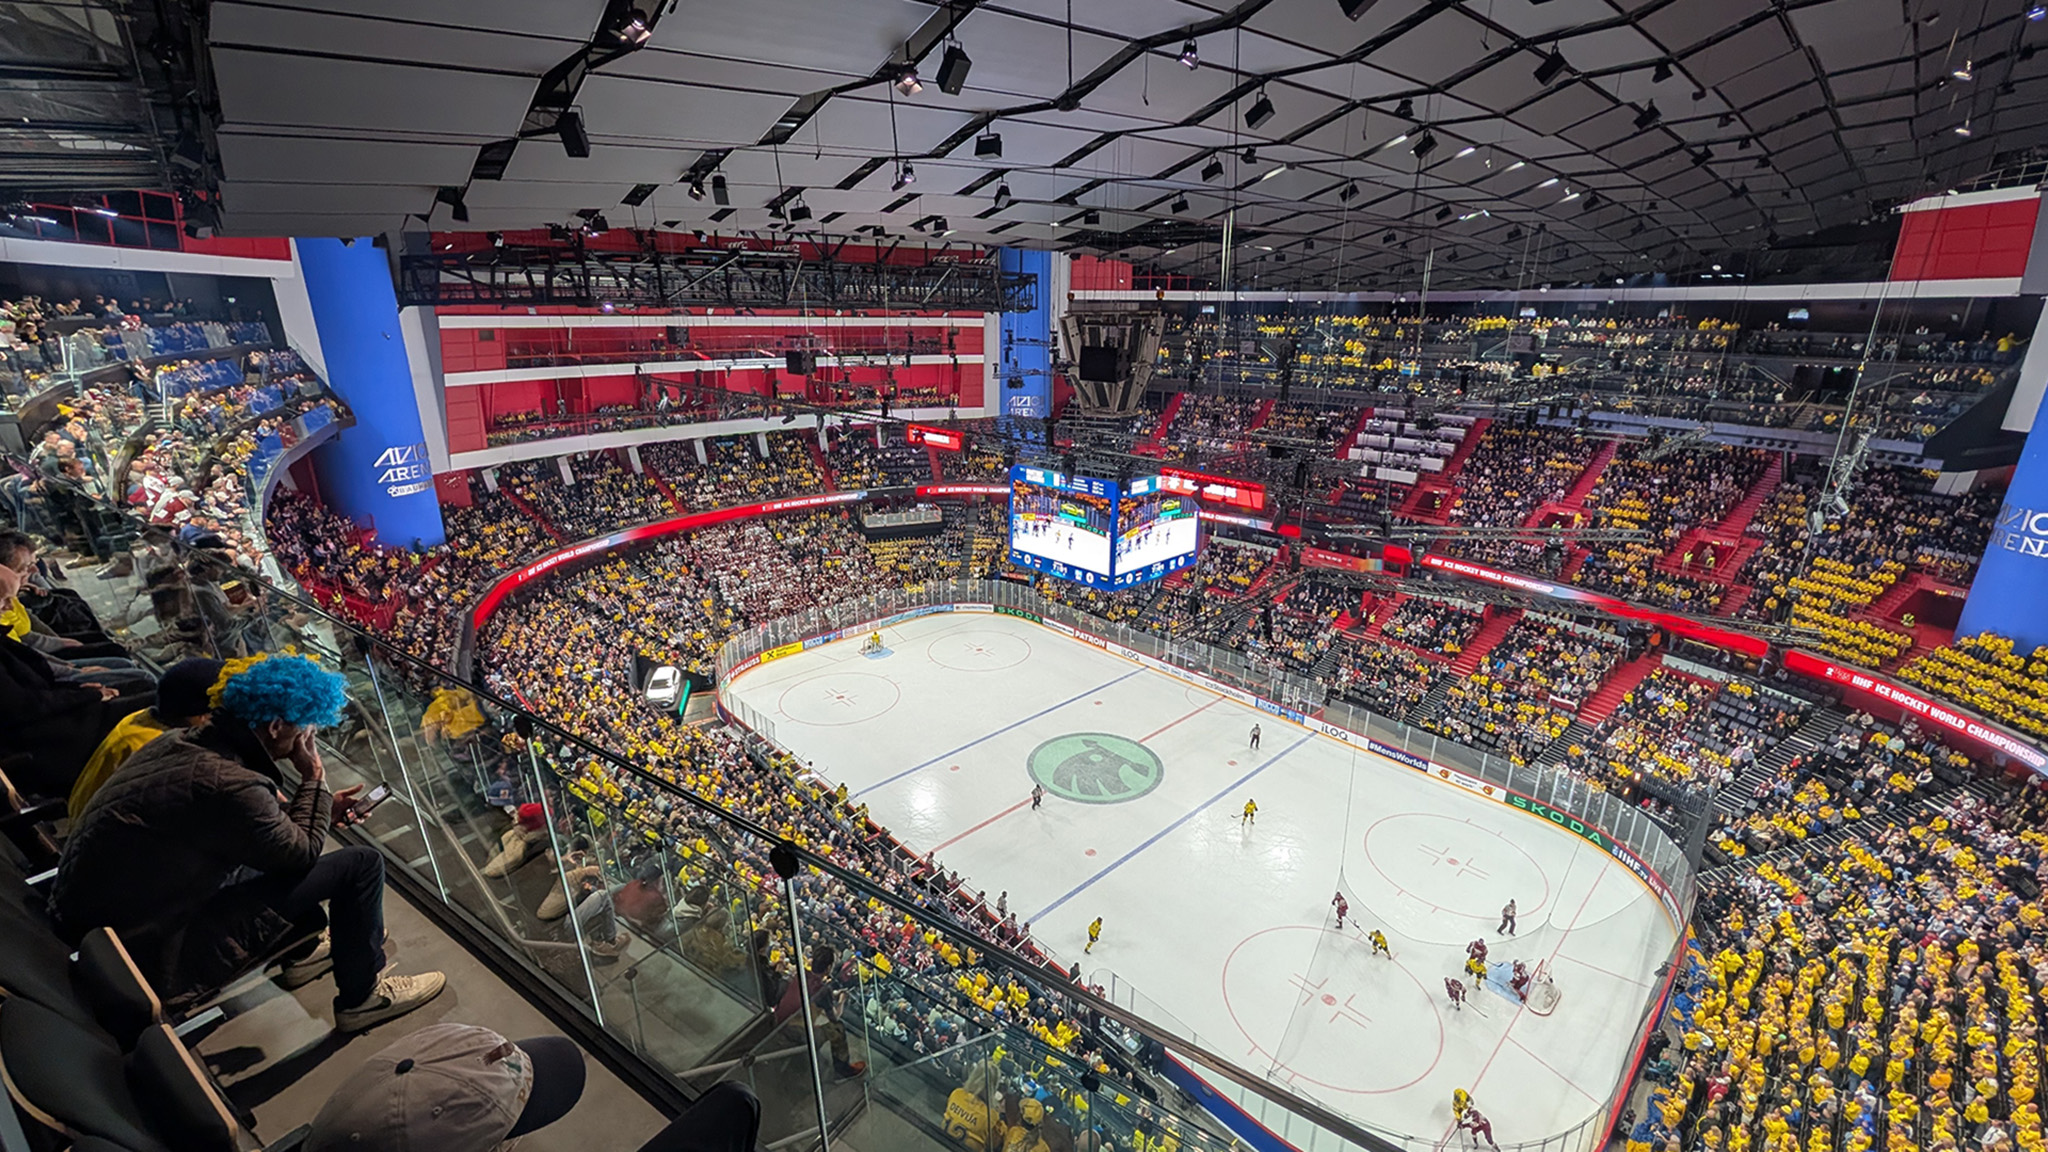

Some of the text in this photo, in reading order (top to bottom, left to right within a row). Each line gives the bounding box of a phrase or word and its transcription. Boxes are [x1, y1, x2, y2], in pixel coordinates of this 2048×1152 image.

[1454, 563, 1479, 575] HOCKEY
[1479, 568, 1502, 581] WORLD
[1075, 630, 1106, 648] PATRON
[1852, 675, 2046, 767] IIHF ICE HOCKEY WORLD CHAMPIONSHIP
[1320, 723, 1349, 742] iLOQ
[1369, 742, 1427, 770] #MensWorlds
